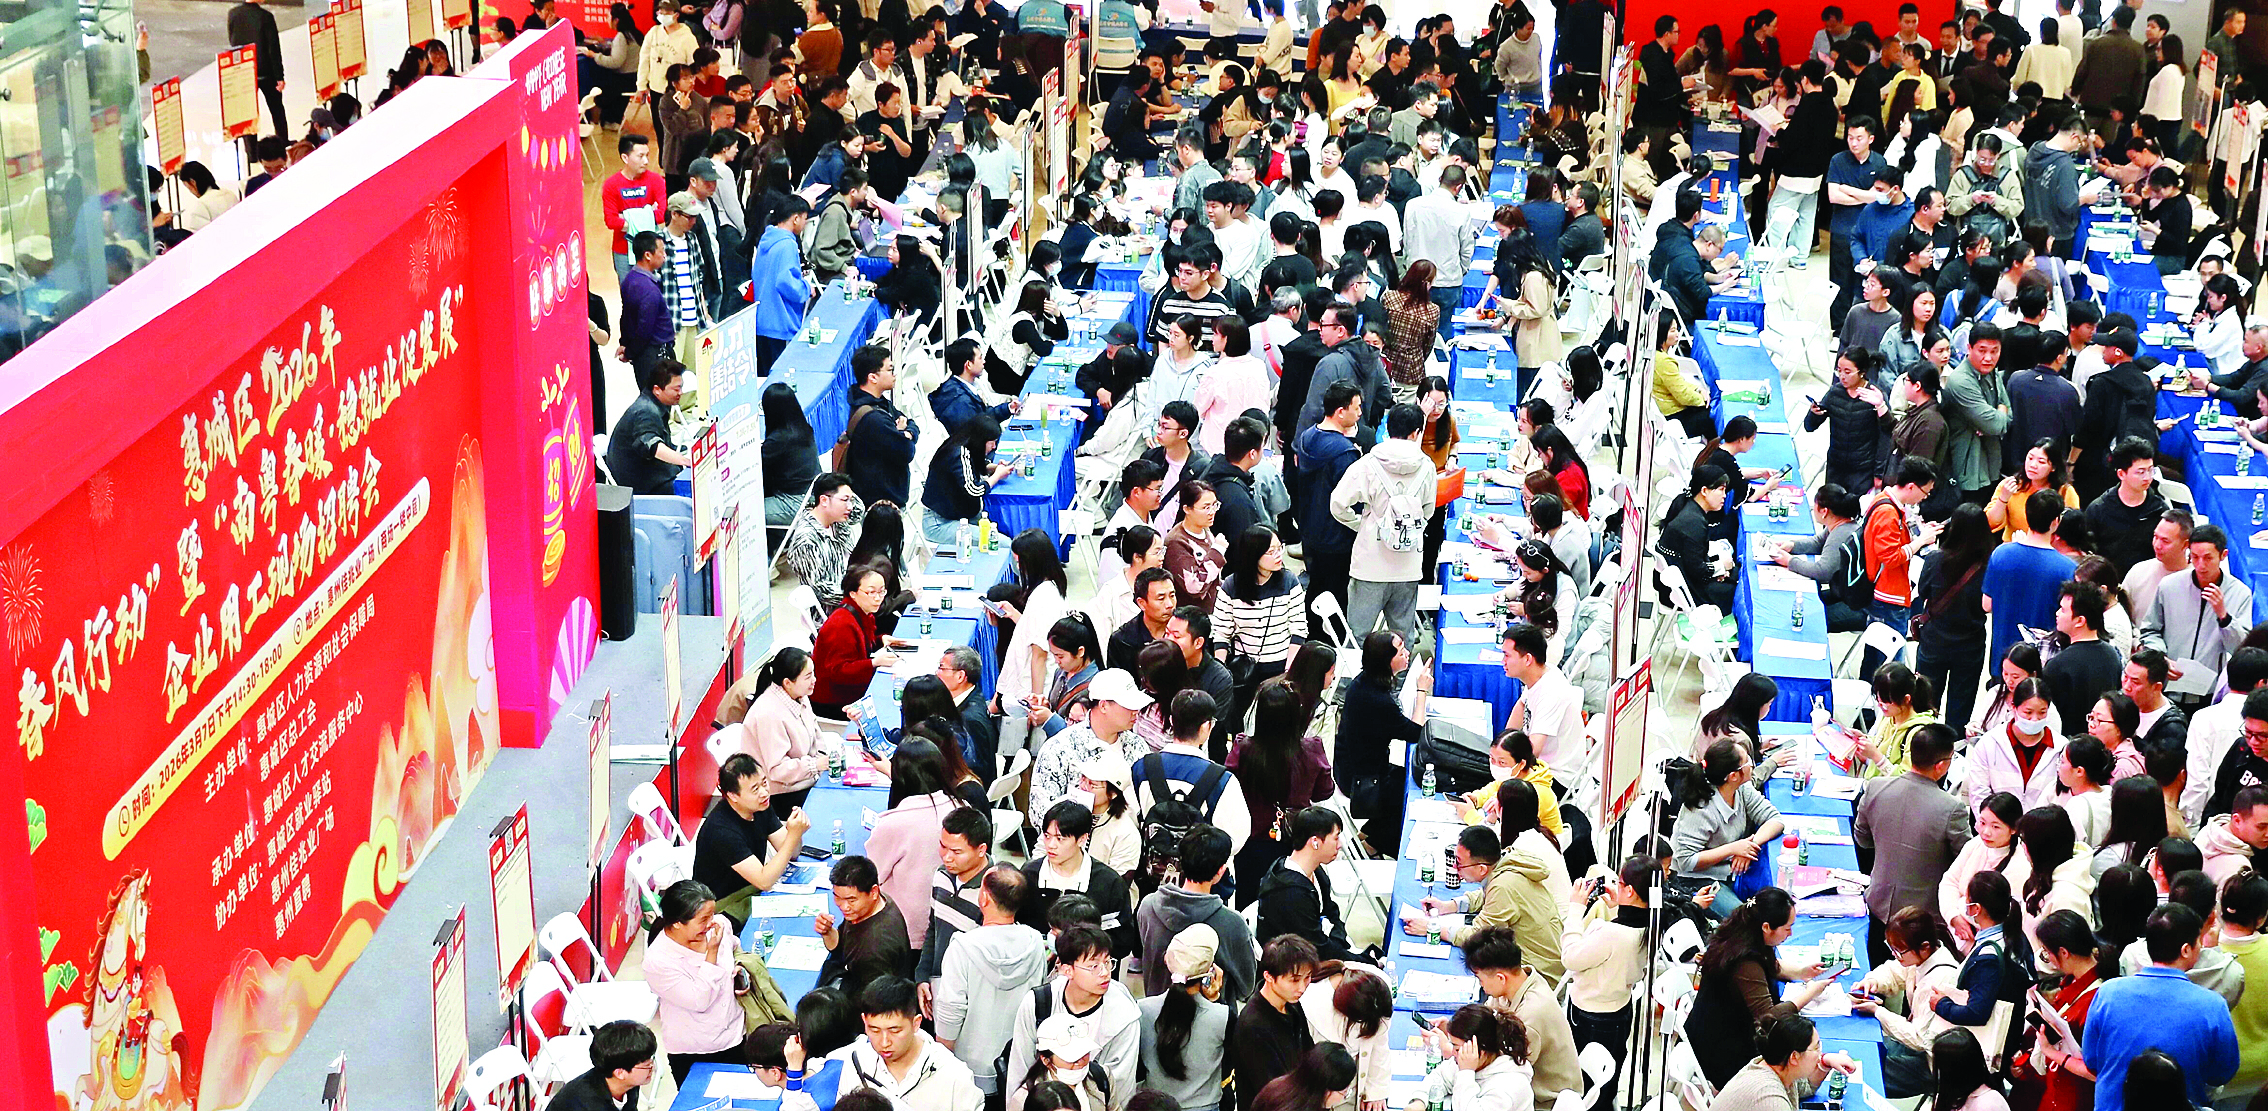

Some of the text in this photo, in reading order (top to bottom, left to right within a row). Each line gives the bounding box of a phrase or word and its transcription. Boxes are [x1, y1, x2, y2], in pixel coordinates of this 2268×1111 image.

[525, 45, 566, 96] HAPPY CHINESE
[540, 71, 568, 112] NEW YEAR
[162, 447, 382, 724] 企业用工现场招聘会
[259, 699, 317, 782] 惠城区总工会
